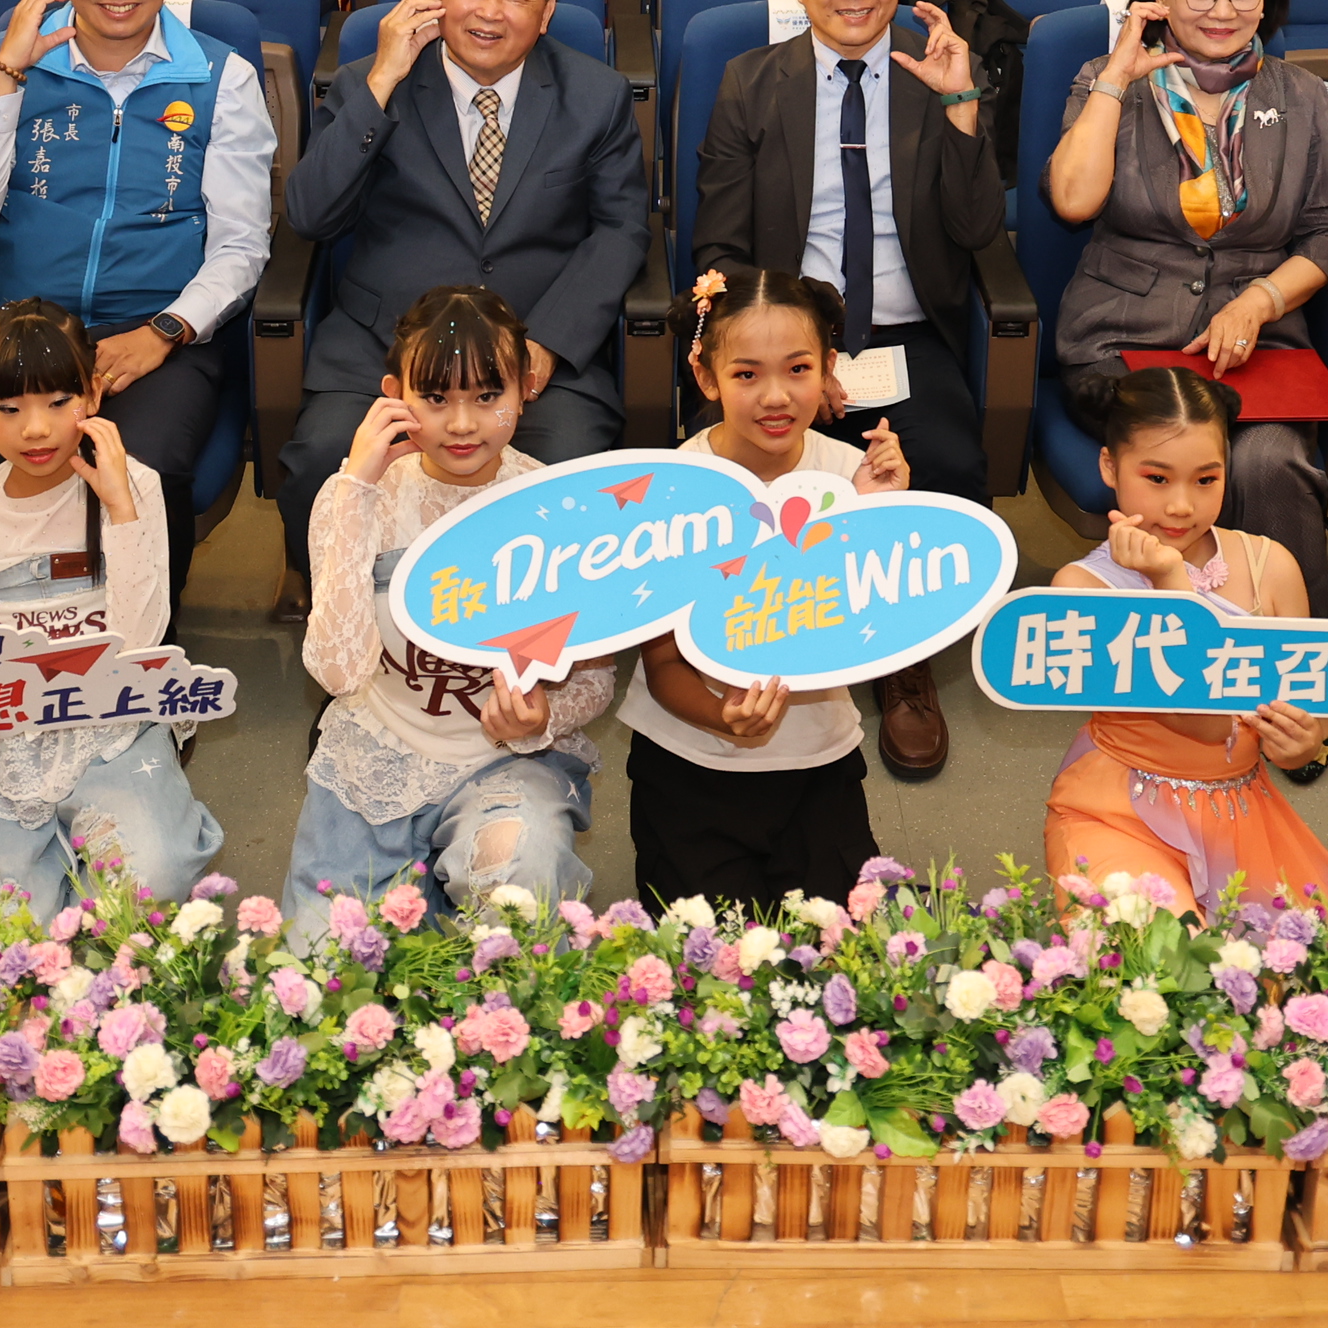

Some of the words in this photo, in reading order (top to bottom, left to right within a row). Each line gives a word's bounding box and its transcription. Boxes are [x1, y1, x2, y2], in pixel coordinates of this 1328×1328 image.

[63, 102, 83, 142] 市長
[428, 565, 488, 628] 敢
[490, 503, 734, 607] Dream
[723, 562, 846, 653] 就能
[844, 530, 971, 616] Win
[12, 605, 79, 630] NEWS
